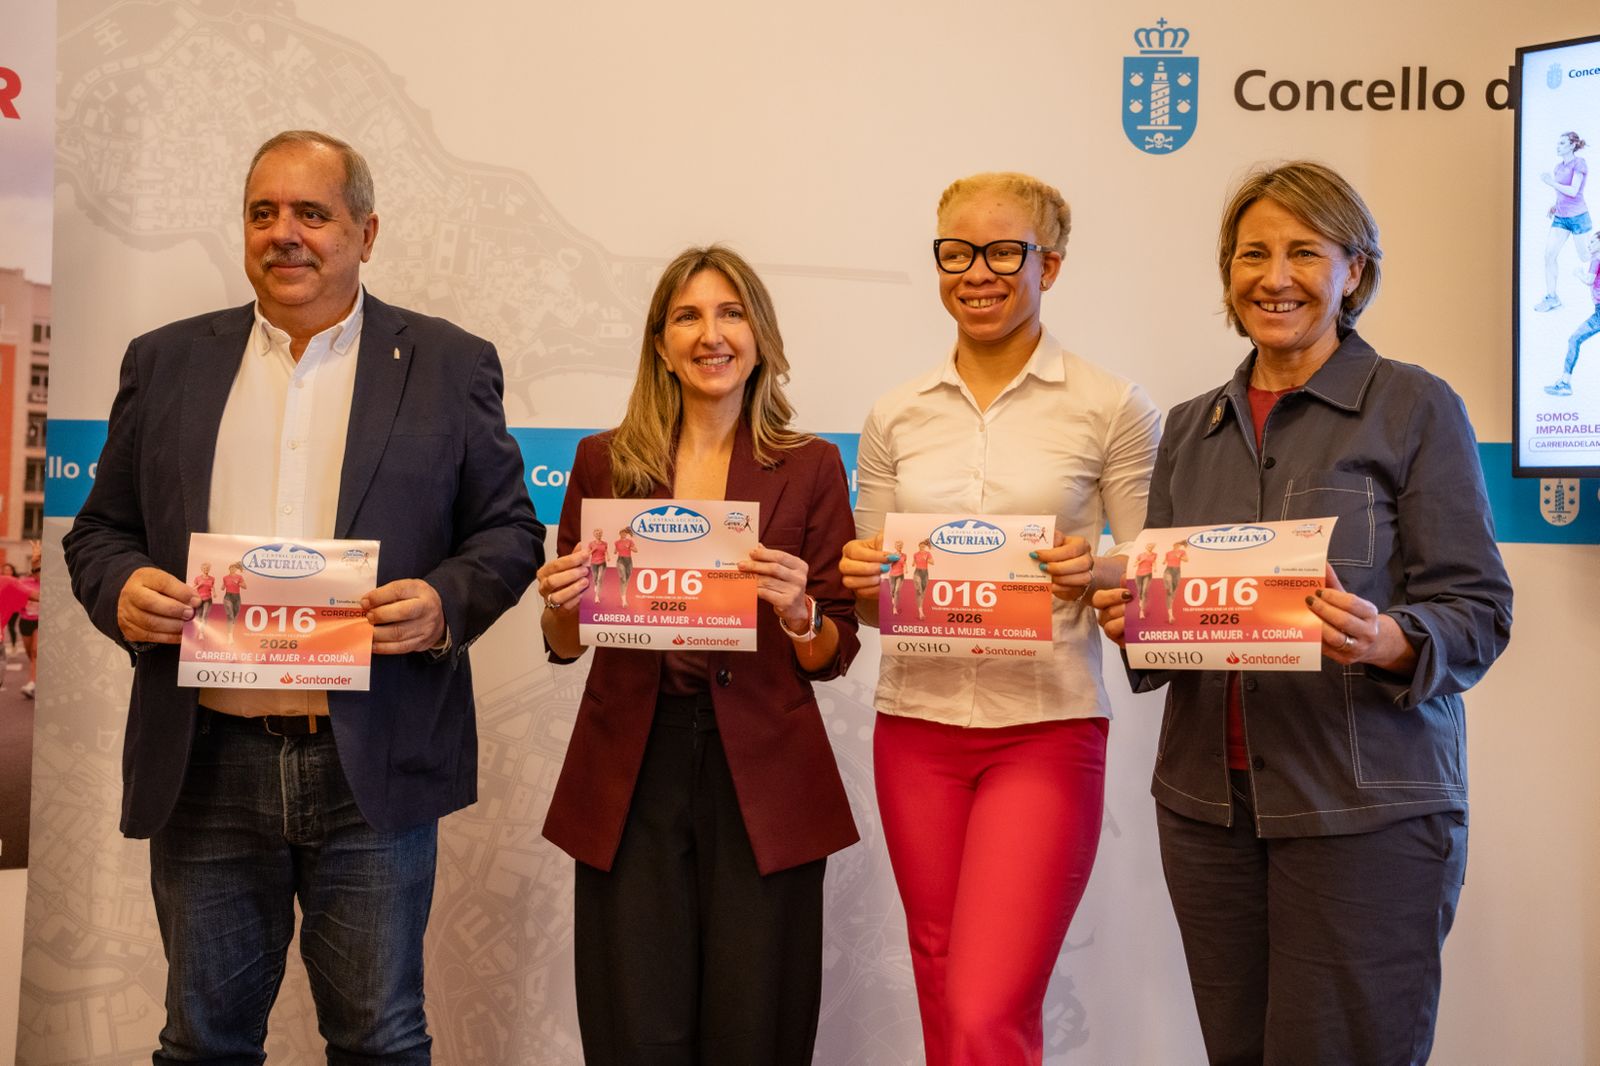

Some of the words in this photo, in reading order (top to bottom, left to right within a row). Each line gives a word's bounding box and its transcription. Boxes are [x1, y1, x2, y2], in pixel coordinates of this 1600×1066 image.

[1234, 66, 1466, 112] Concello
[1536, 412, 1579, 422] SOMOS
[45, 456, 80, 479] llo
[637, 519, 704, 533] ASTURIANA
[935, 530, 1000, 545] ASTURIANA
[1193, 534, 1267, 543] ASTURIANA
[248, 554, 320, 570] ASTURIANA
[636, 569, 703, 595] 016
[1002, 584, 1050, 593] CORREDORA
[1264, 579, 1322, 588] CORREDORA
[932, 581, 997, 608] 016
[1184, 577, 1259, 607] 016
[651, 601, 687, 612] 2026
[245, 606, 317, 634] 016
[593, 613, 631, 623] CARRERA
[634, 614, 645, 624] DE
[647, 615, 658, 624] LA
[661, 615, 689, 625] MUJER
[697, 616, 703, 625] A
[706, 615, 742, 626] CORUÑA
[947, 613, 983, 624] 2026
[1200, 613, 1240, 625] 2026
[892, 624, 930, 634] CARRERA
[932, 626, 943, 634] DE
[945, 626, 955, 635] LA
[957, 627, 986, 636] MUJER
[994, 628, 1000, 636] A
[1002, 627, 1038, 638] CORUÑA
[1138, 630, 1180, 641] CARRERA
[1182, 630, 1194, 640] DE
[1197, 630, 1208, 640] LA
[1211, 629, 1243, 640] MUJER
[1252, 630, 1260, 639] A
[1262, 627, 1303, 639] CORUÑA
[260, 639, 298, 649] 2026
[597, 631, 652, 645] OYSHO
[687, 636, 740, 647] Santander
[897, 641, 950, 654] OYSHO
[985, 647, 1036, 657] Santander
[195, 651, 237, 661] CARRERA
[241, 652, 253, 662] DE
[255, 653, 267, 662] LA
[269, 653, 300, 663] MUJER
[308, 654, 315, 663] A
[317, 652, 355, 664] CORUÑA
[1145, 651, 1203, 665] OYSHO
[1242, 653, 1300, 665] Santander
[197, 669, 258, 684] OYSHO
[296, 674, 352, 685] Santander
